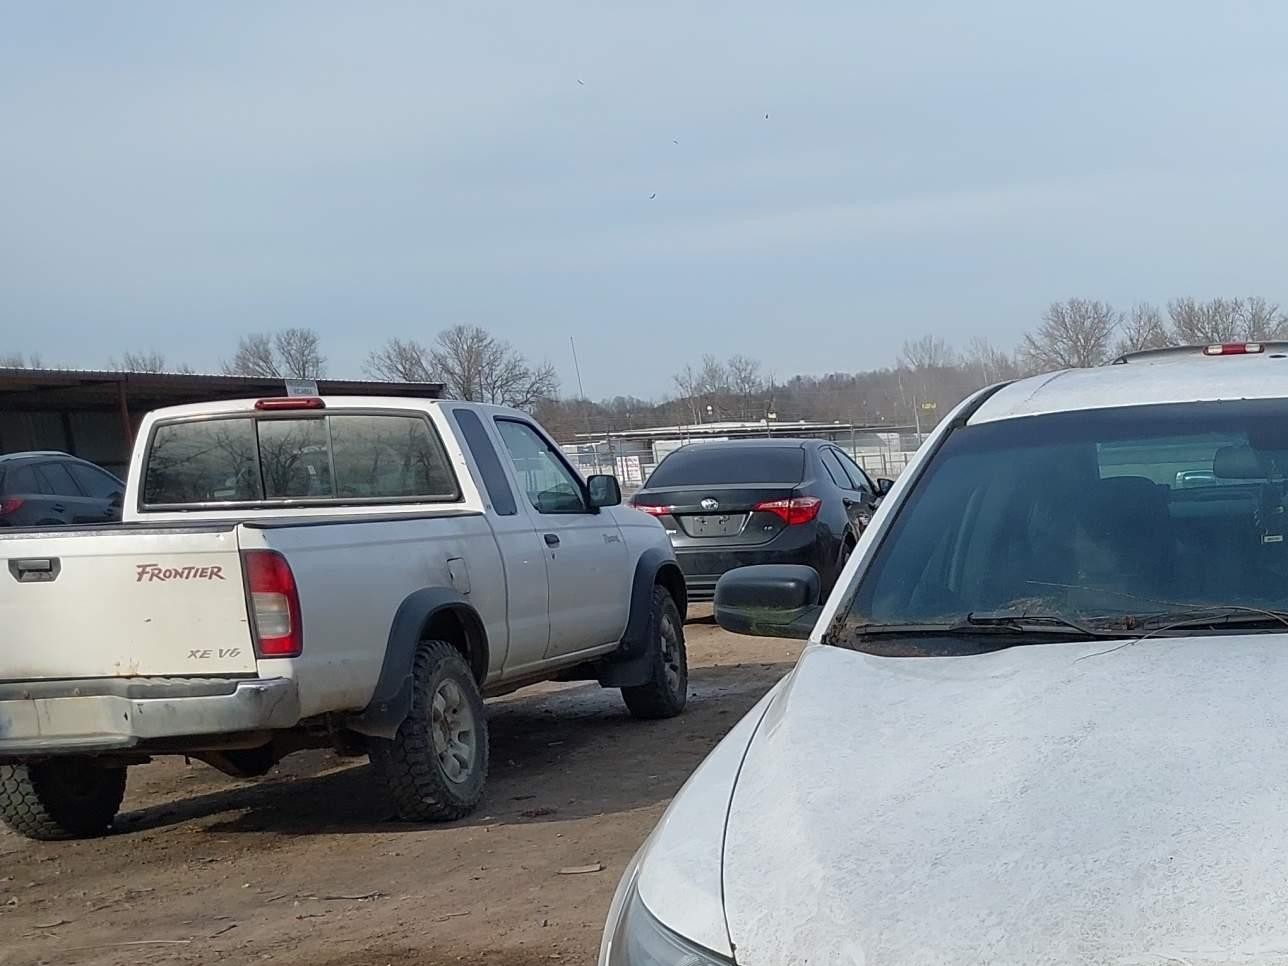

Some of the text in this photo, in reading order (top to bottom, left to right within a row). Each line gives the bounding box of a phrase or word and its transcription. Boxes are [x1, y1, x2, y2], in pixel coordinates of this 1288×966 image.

[136, 563, 226, 582] FRONTIER
[187, 648, 241, 659] XE V6
